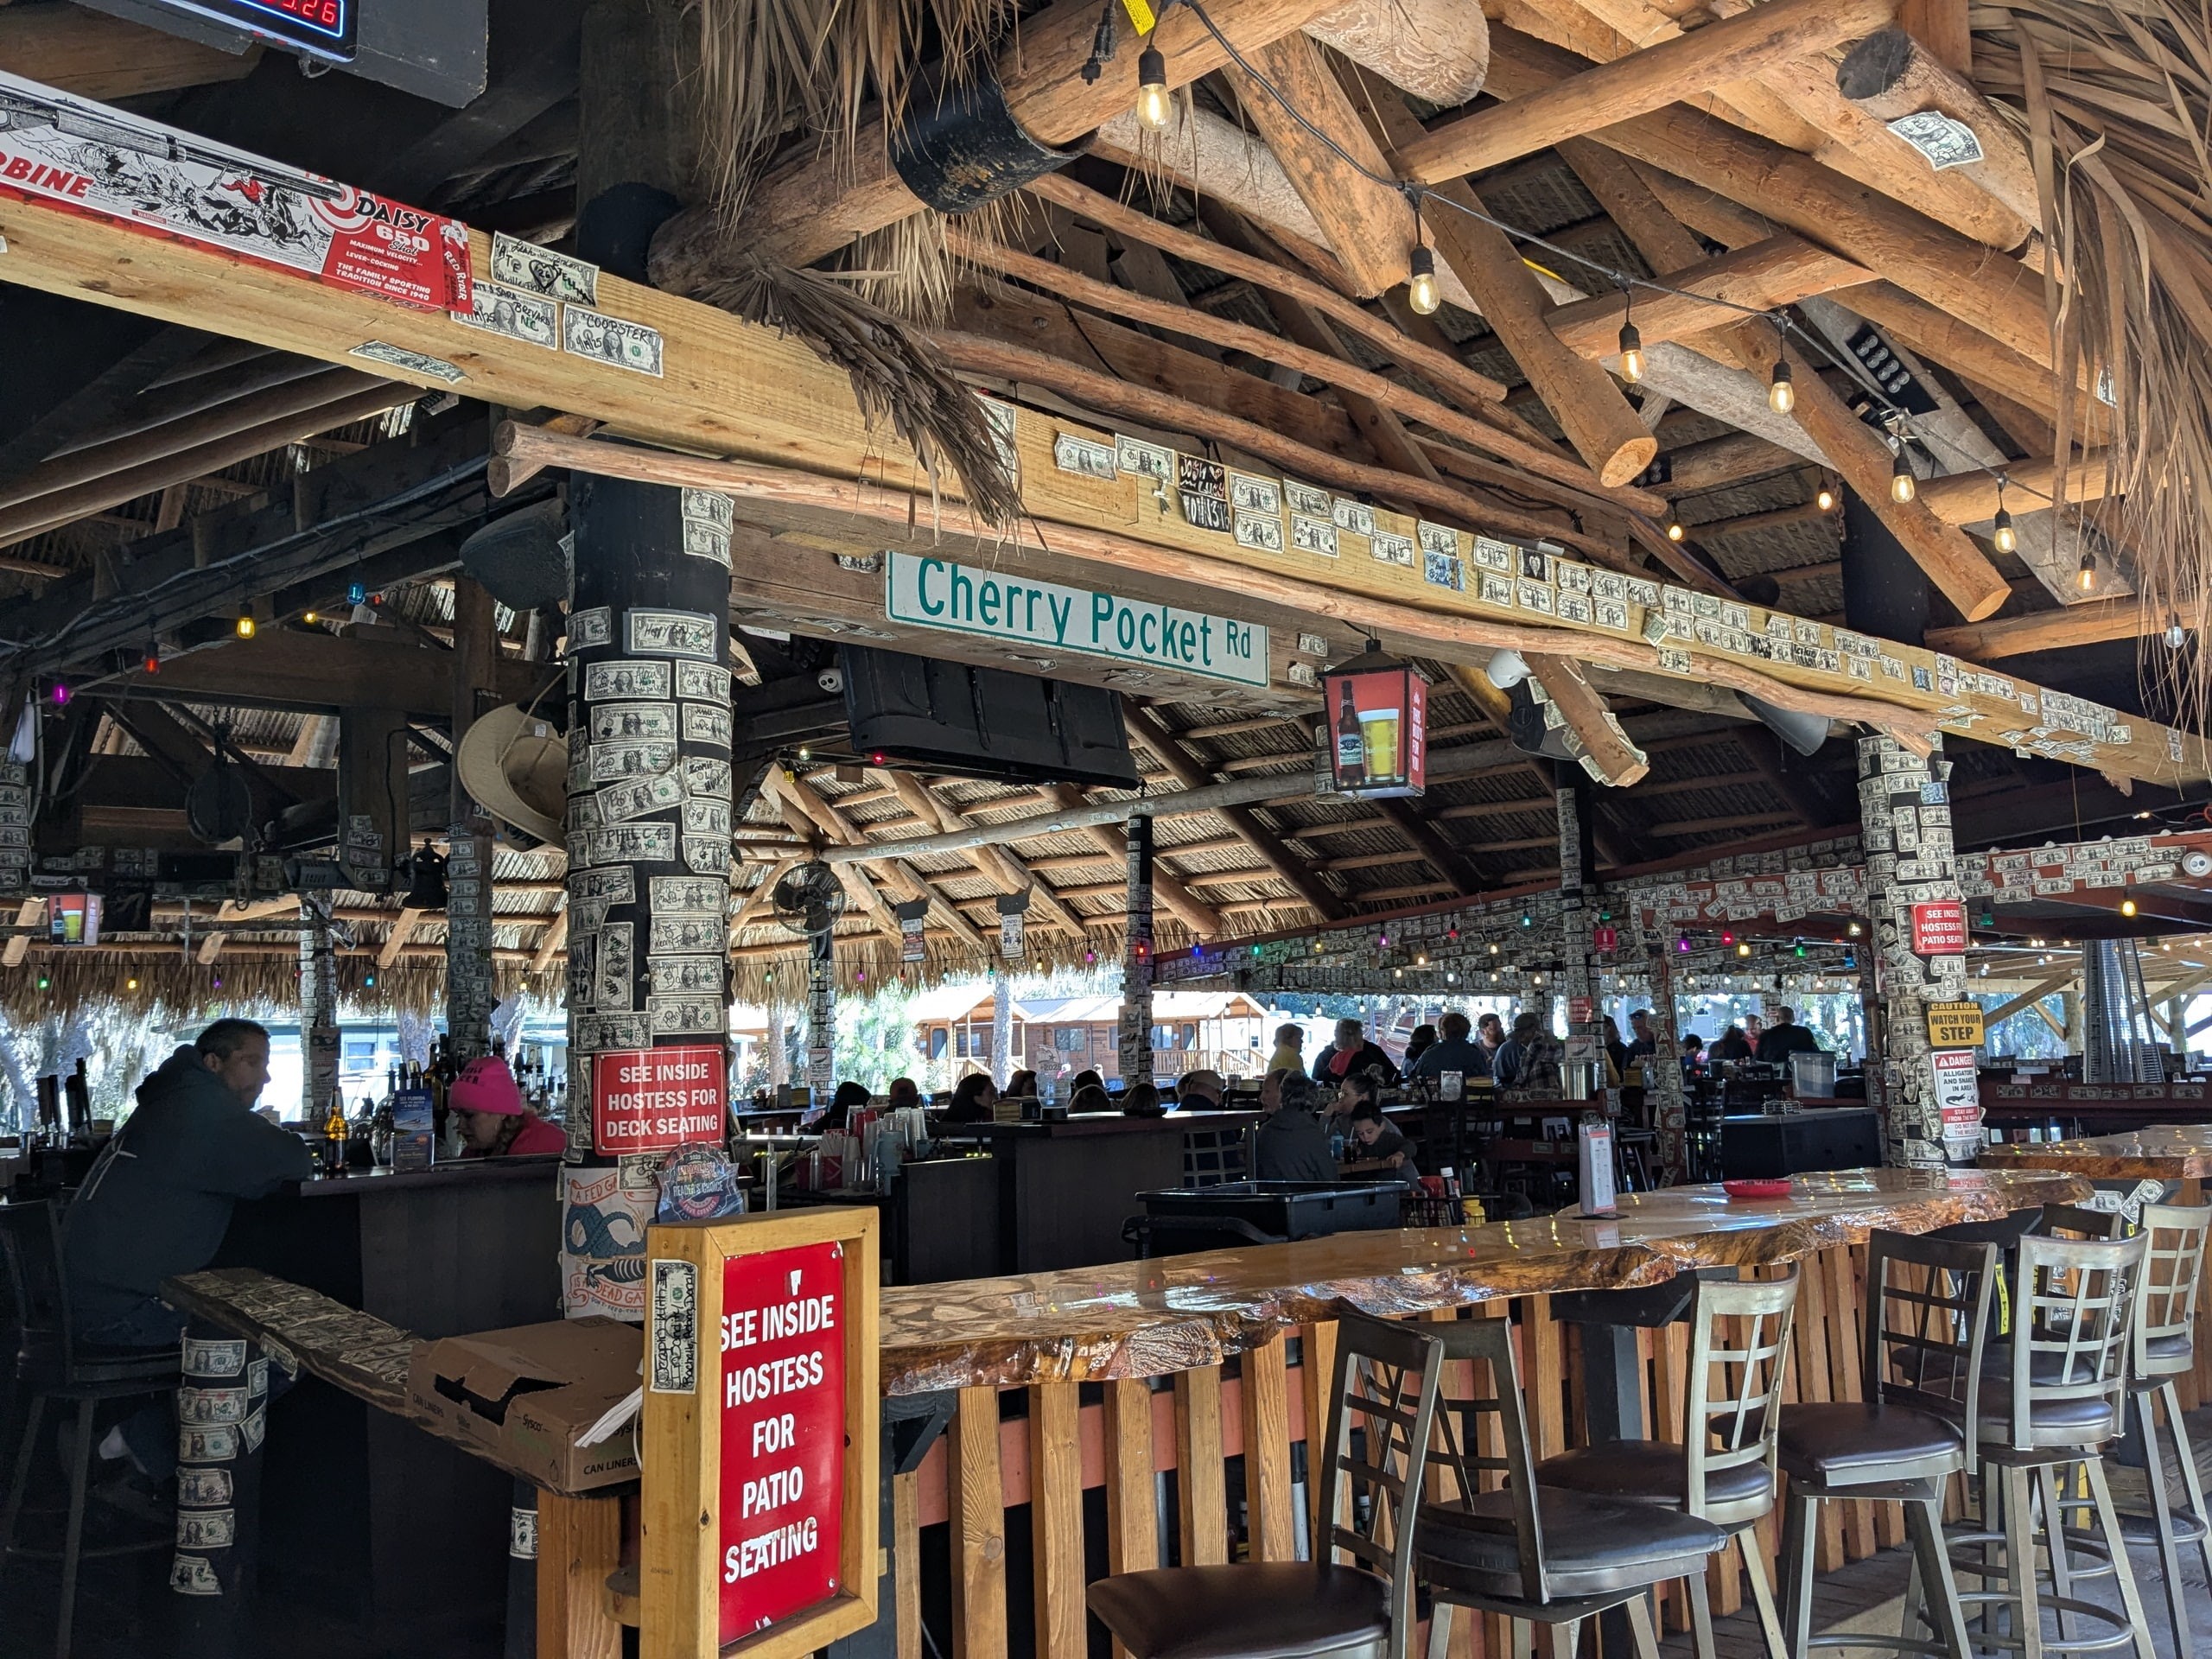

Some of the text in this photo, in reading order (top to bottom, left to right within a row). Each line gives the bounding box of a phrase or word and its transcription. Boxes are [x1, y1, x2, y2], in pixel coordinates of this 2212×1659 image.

[355, 196, 431, 235] DAISY
[349, 239, 385, 255] MAXIMUM
[376, 225, 430, 251] 650
[389, 240, 418, 256] Shot
[346, 251, 399, 271] LEVER-COCKING
[335, 269, 430, 301] TRADITION SINCE 1940
[337, 262, 431, 294] THE FAMILY SPORTING
[444, 250, 467, 301] RED RYDER
[520, 315, 540, 332] NC
[1181, 456, 1207, 480] JOSH
[918, 557, 1251, 666] Cherry Pocket Rd
[1927, 910, 1943, 918] SEE
[1921, 922, 1956, 932] HOSTESS
[1922, 936, 1946, 944] PATIO
[1930, 1001, 1979, 1010] CAUTION
[1930, 1014, 1981, 1026] WATCH YOUR
[1940, 1027, 1974, 1041] STEP
[620, 1063, 709, 1084] SEE INSIDE
[607, 1088, 717, 1111] HOSTESS FOR
[606, 1114, 718, 1138] DECK SEATING
[575, 1192, 582, 1202] A
[584, 1185, 603, 1200] FED
[702, 1180, 724, 1193] CHOICE
[574, 1277, 582, 1287] IS
[595, 1282, 622, 1301] DEAD
[721, 1294, 835, 1353] SEE INSIDE
[727, 1350, 824, 1409] HOSTESS
[523, 1414, 543, 1432] Sysco
[752, 1412, 796, 1459] FOR
[583, 1463, 605, 1475] CAN
[742, 1465, 804, 1520] PATIO
[724, 1516, 818, 1584] SEATING
